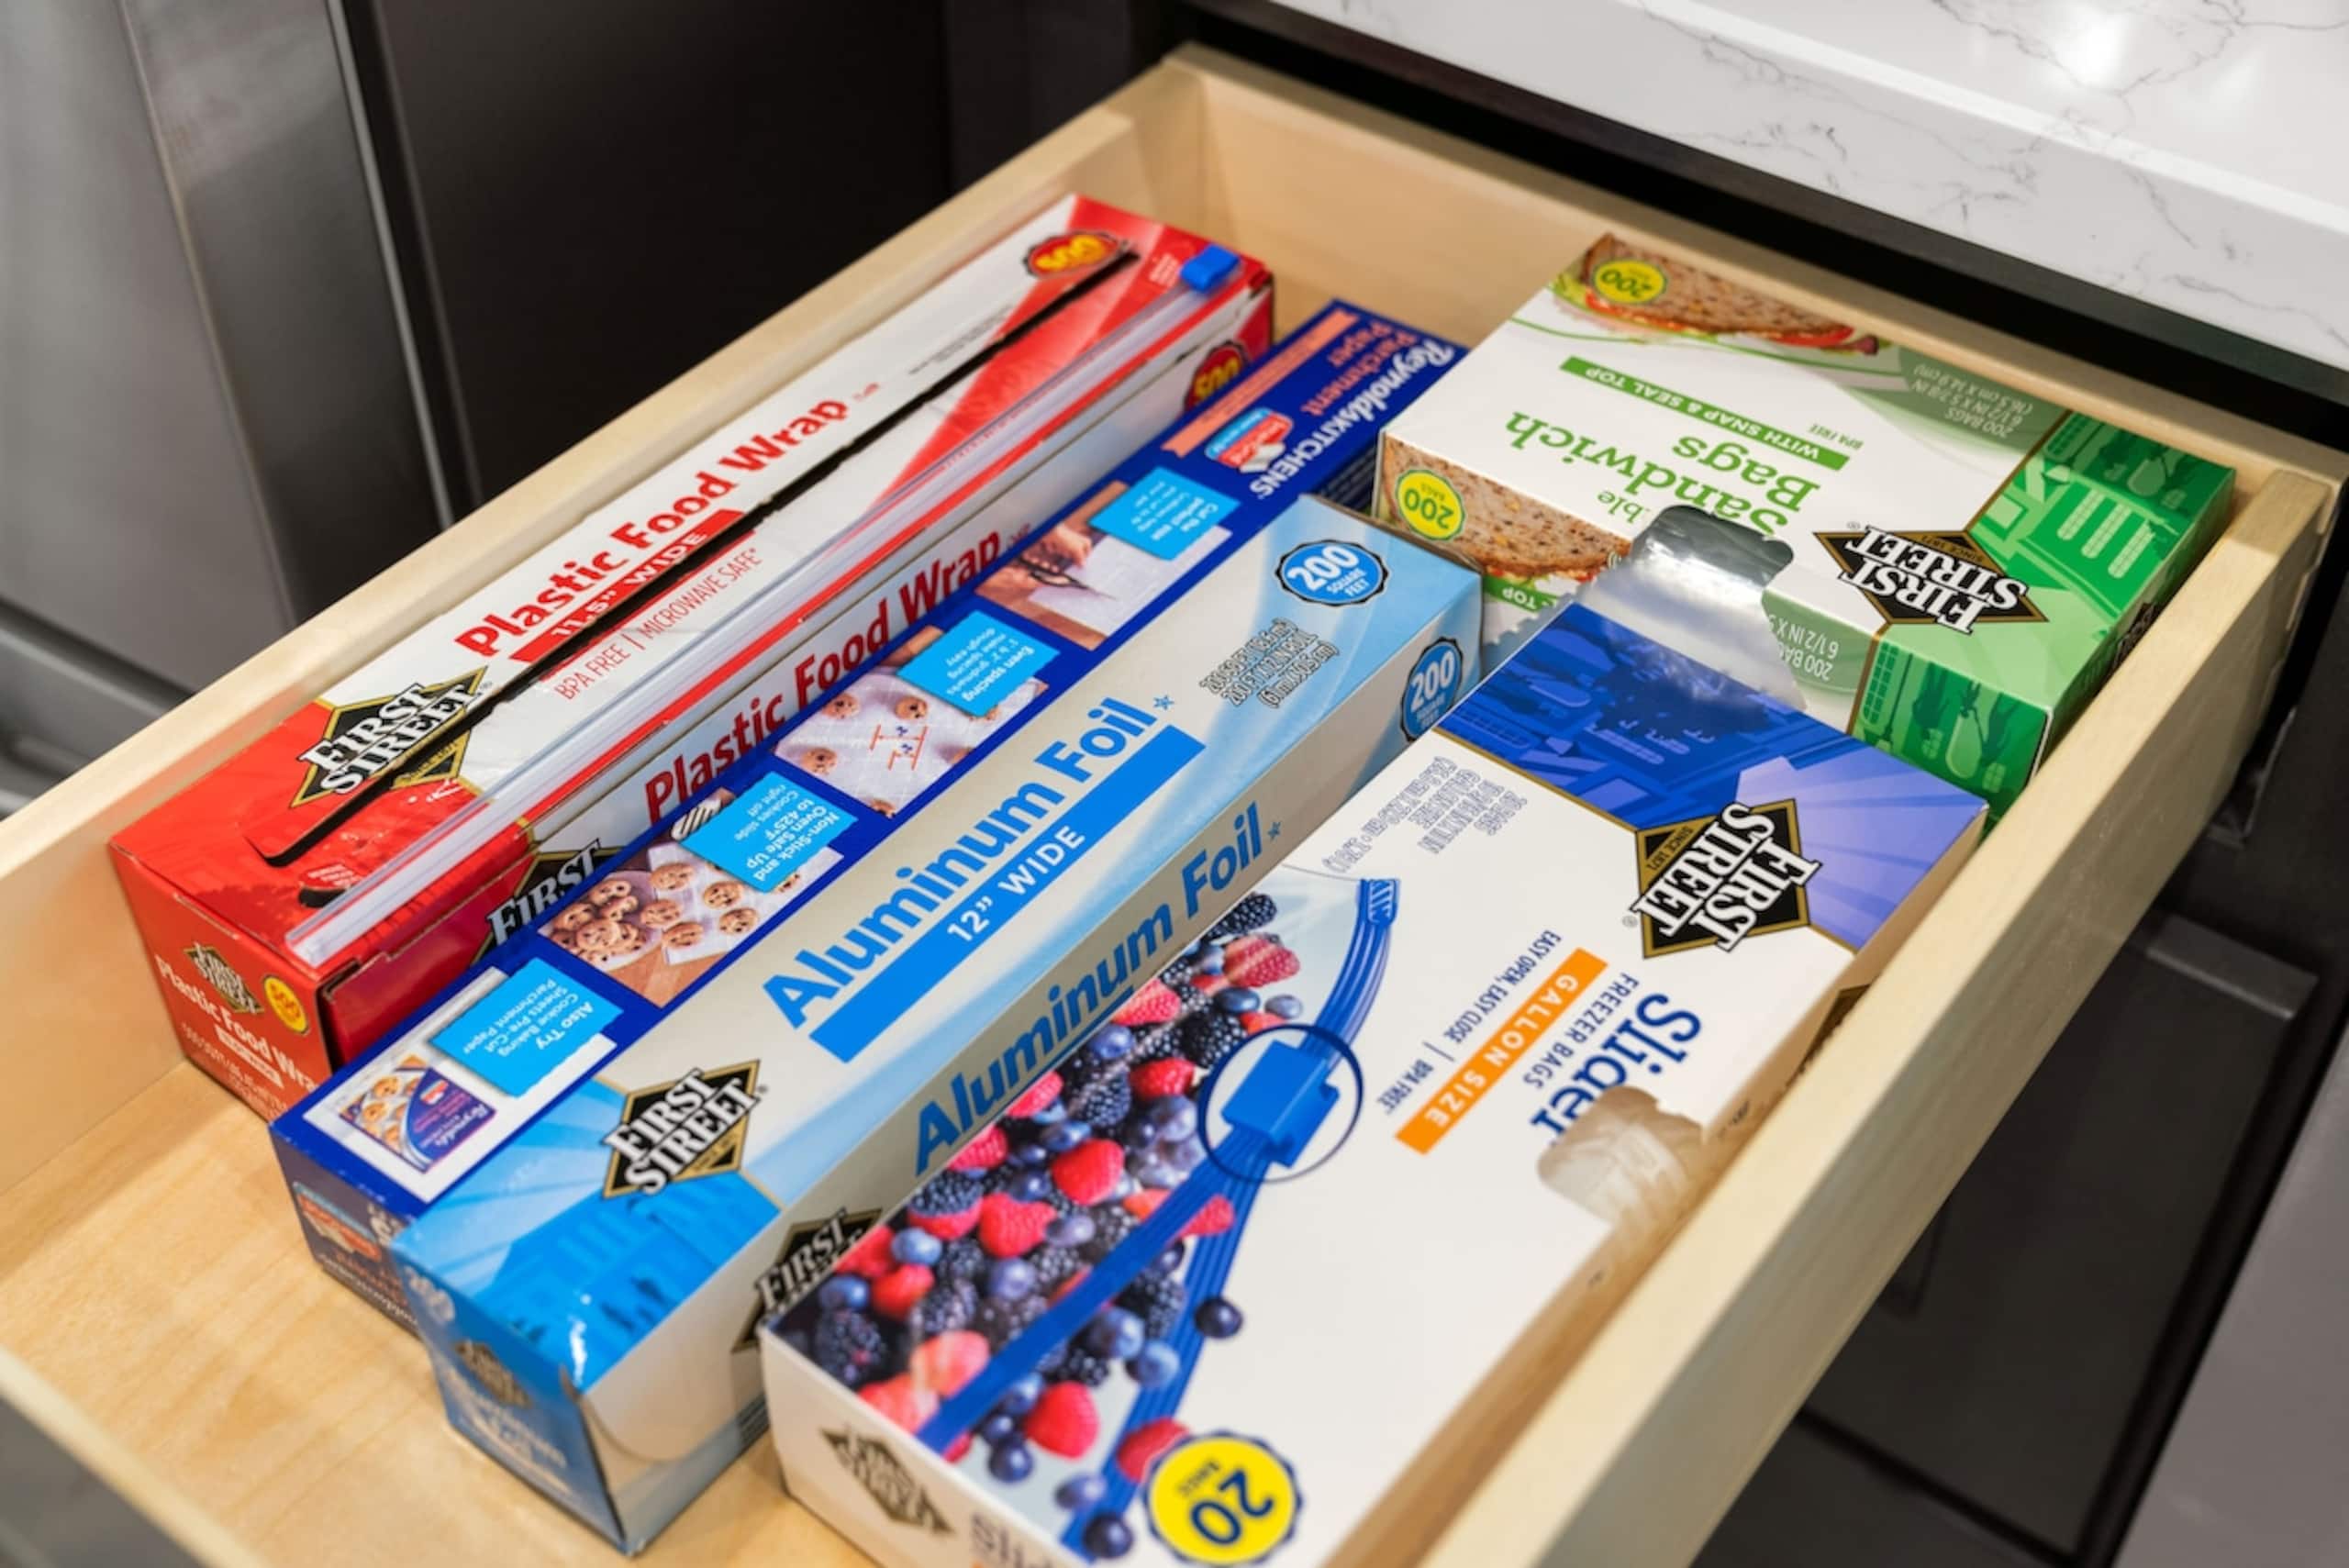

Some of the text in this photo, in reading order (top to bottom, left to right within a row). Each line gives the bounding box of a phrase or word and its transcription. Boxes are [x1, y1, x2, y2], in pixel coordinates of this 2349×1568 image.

[1601, 269, 1653, 298] 200
[1300, 329, 1419, 416] Parchment
[1328, 322, 1393, 366] Paper
[1586, 366, 1820, 460] WITH SNAP & SEAL TOP
[1809, 423, 1864, 450] BPA FREE
[1980, 417, 2013, 439] 200
[1404, 488, 1453, 529] 200
[1505, 411, 1788, 536] Sandwich
[1672, 435, 1821, 514] Bags
[455, 400, 847, 657] Plastic Food Wrap
[624, 532, 707, 585] WIDE
[1287, 545, 1359, 591] 200
[1326, 568, 1367, 594] SQUARE
[1343, 578, 1370, 596] FEET
[1501, 584, 1538, 610] TOP
[1837, 556, 1991, 635] FIRST
[1844, 525, 2030, 609] STREET
[554, 670, 598, 701] BPA
[592, 643, 631, 679] FREE
[637, 575, 728, 640] MICROWAVE
[1776, 617, 1788, 638] X
[1788, 623, 1806, 645] IN
[1804, 630, 1827, 655] 1/2
[1827, 640, 1839, 659] 6
[645, 530, 1003, 825] Plastic Food Wrap
[958, 645, 1036, 702] Even spacing
[1410, 651, 1455, 713] 200
[1805, 654, 1833, 681] 200
[296, 682, 435, 771] FIRST
[320, 684, 489, 794] STREET
[741, 805, 829, 869] Oven Safe Up
[754, 790, 800, 823] Cookies
[1668, 825, 1695, 851] SINCE
[751, 812, 841, 881] Non-Stick and
[763, 696, 1158, 1029] Aluminum Foil
[999, 825, 1086, 896] WIDE
[1629, 802, 1775, 937] STREET
[487, 839, 602, 946] FIRST
[1688, 836, 1823, 952] FIRST
[154, 953, 222, 1021] Plastic
[219, 1006, 275, 1062] Food
[272, 1046, 319, 1093] Wra
[458, 978, 558, 1055] Parchment Paper
[482, 985, 570, 1053] Sheets Pre-Cut
[916, 801, 1264, 1175] Aluminum Foil
[1443, 929, 1563, 1044] EASY OPEN, EASY CLOSE
[495, 992, 581, 1058] Cookie Baking
[529, 1001, 596, 1051] Also Try
[1425, 973, 1580, 1128] GALLON SIZE
[1523, 973, 1641, 1088] FREEZER BAGS
[1409, 1058, 1435, 1086] BPA
[1530, 994, 1703, 1137] Slider
[601, 1067, 719, 1162] FIRST
[624, 1077, 762, 1195] STREET
[754, 1207, 847, 1312] FIRST
[1190, 1469, 1275, 1545] 20
